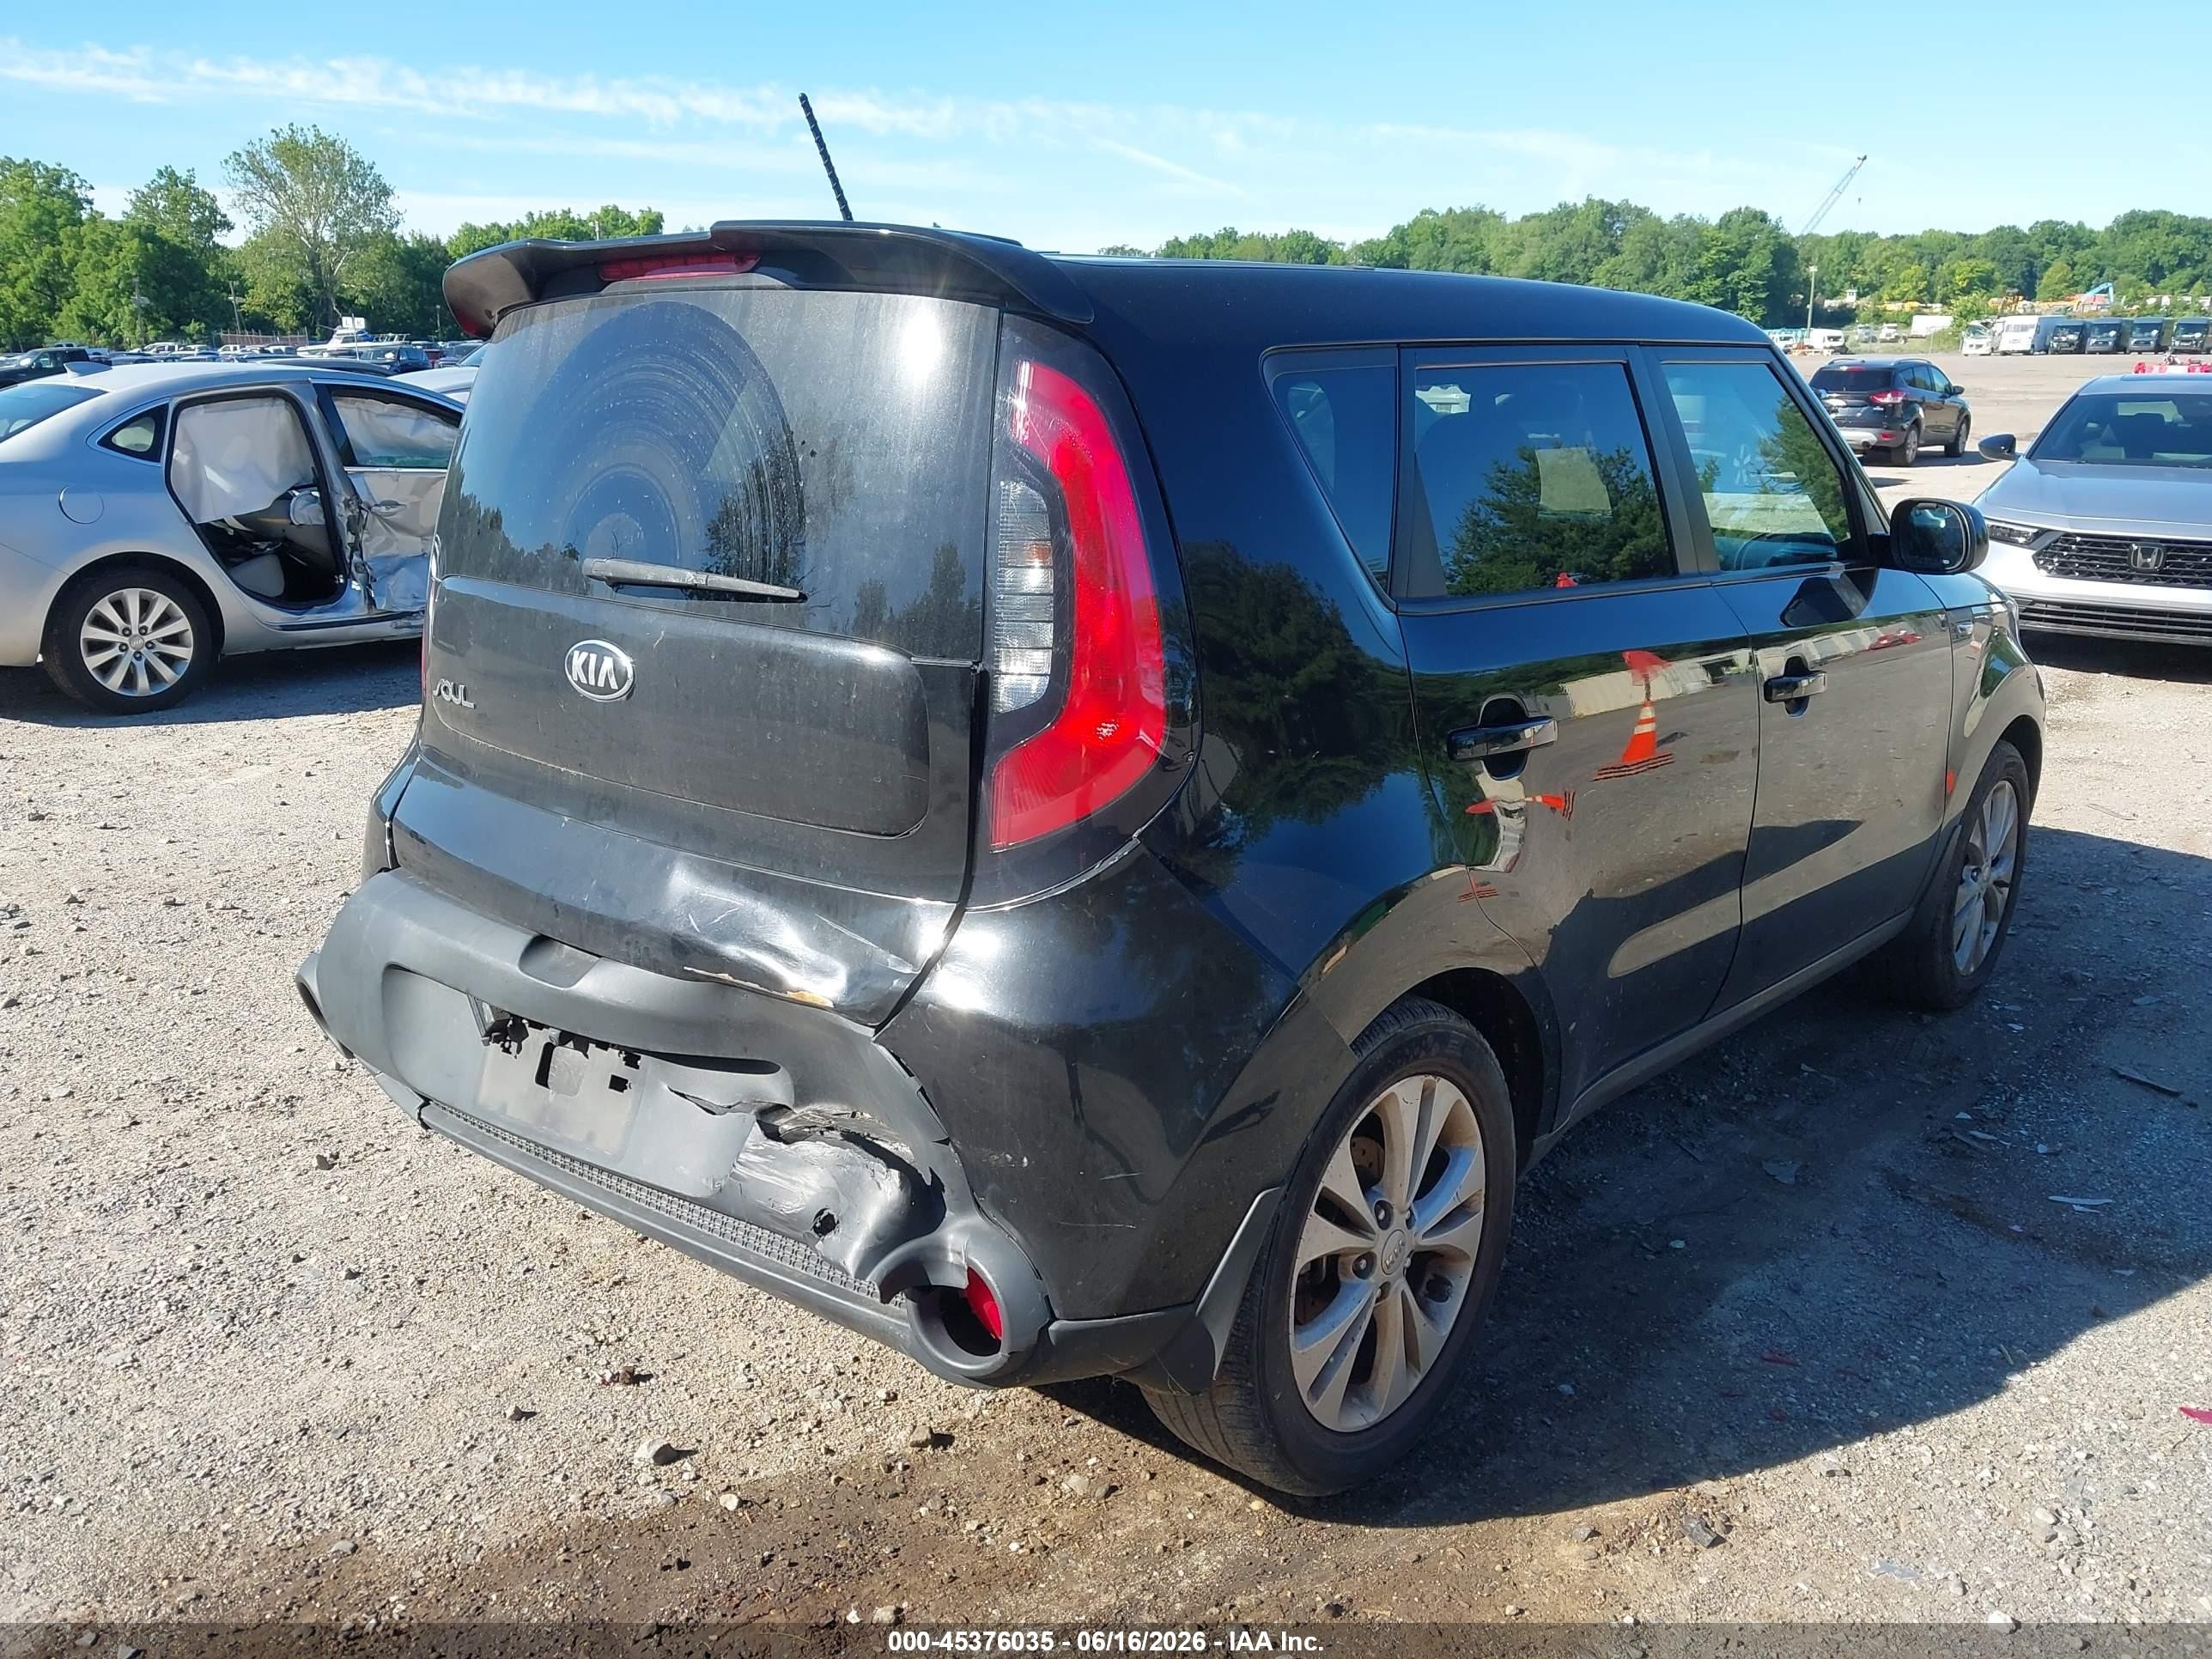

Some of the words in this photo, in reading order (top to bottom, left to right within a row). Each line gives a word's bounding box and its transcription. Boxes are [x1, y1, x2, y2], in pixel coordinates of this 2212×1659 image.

[571, 649, 619, 690] KIA
[432, 678, 475, 709] SOUL
[1384, 1238, 1406, 1270] KIA
